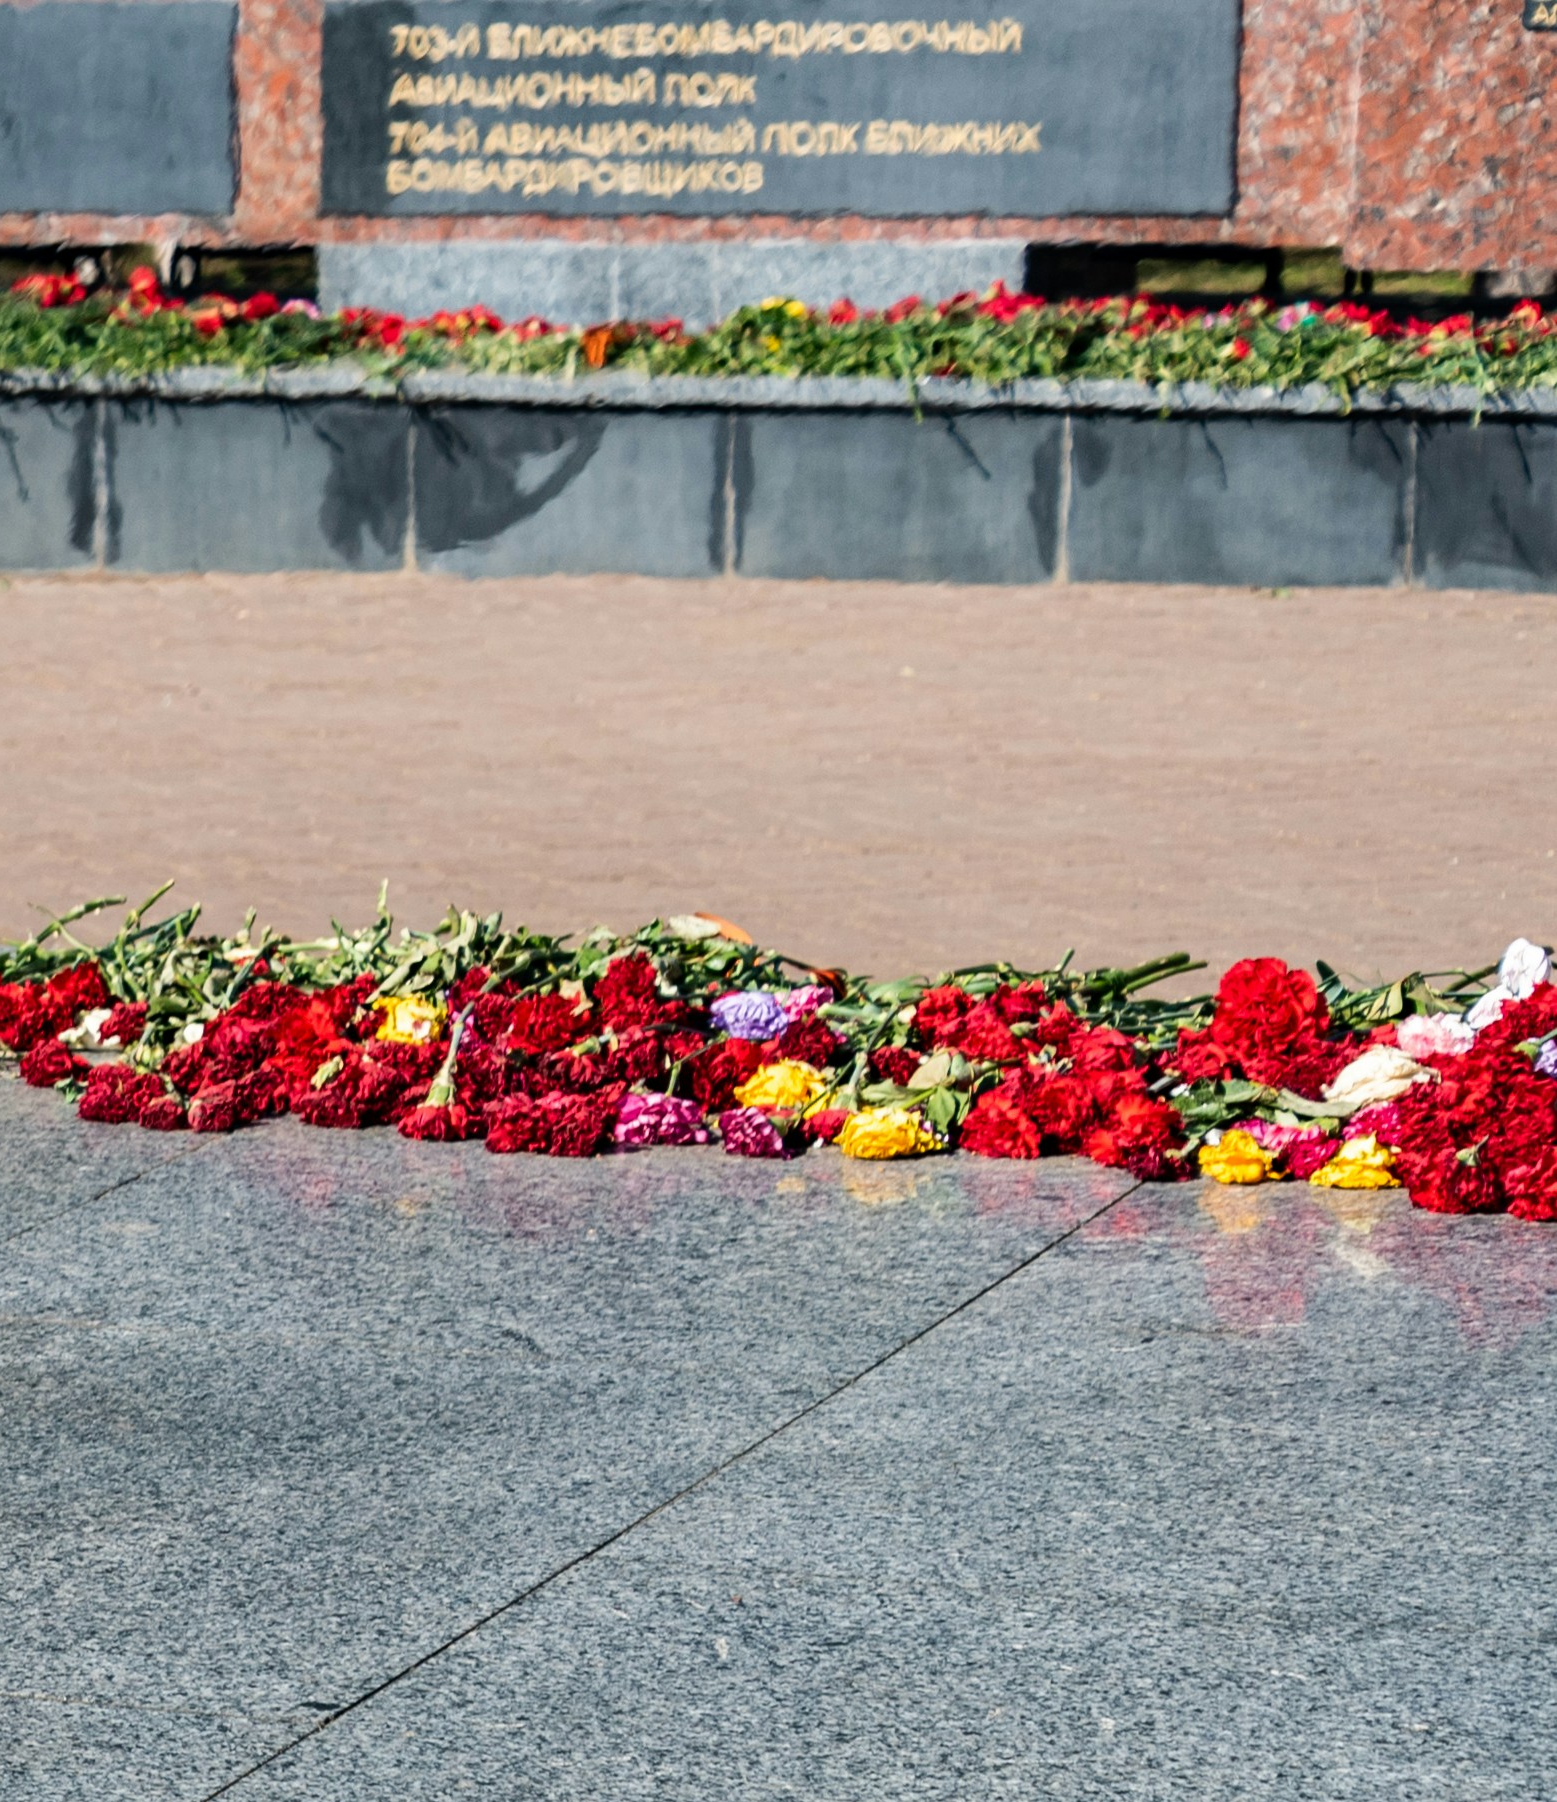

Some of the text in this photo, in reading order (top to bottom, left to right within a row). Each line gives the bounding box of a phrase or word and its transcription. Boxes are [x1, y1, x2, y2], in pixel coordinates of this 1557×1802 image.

[389, 67, 757, 109] АВИАЦИОННЫЙ ПОЛК
[482, 117, 756, 159] АВИАЦИОННЫЙ
[761, 120, 862, 157] ПОЛК
[864, 119, 1043, 157] БЛИЖНИХ
[385, 157, 764, 200] БОМБАРДИРОВЩИКОВ
